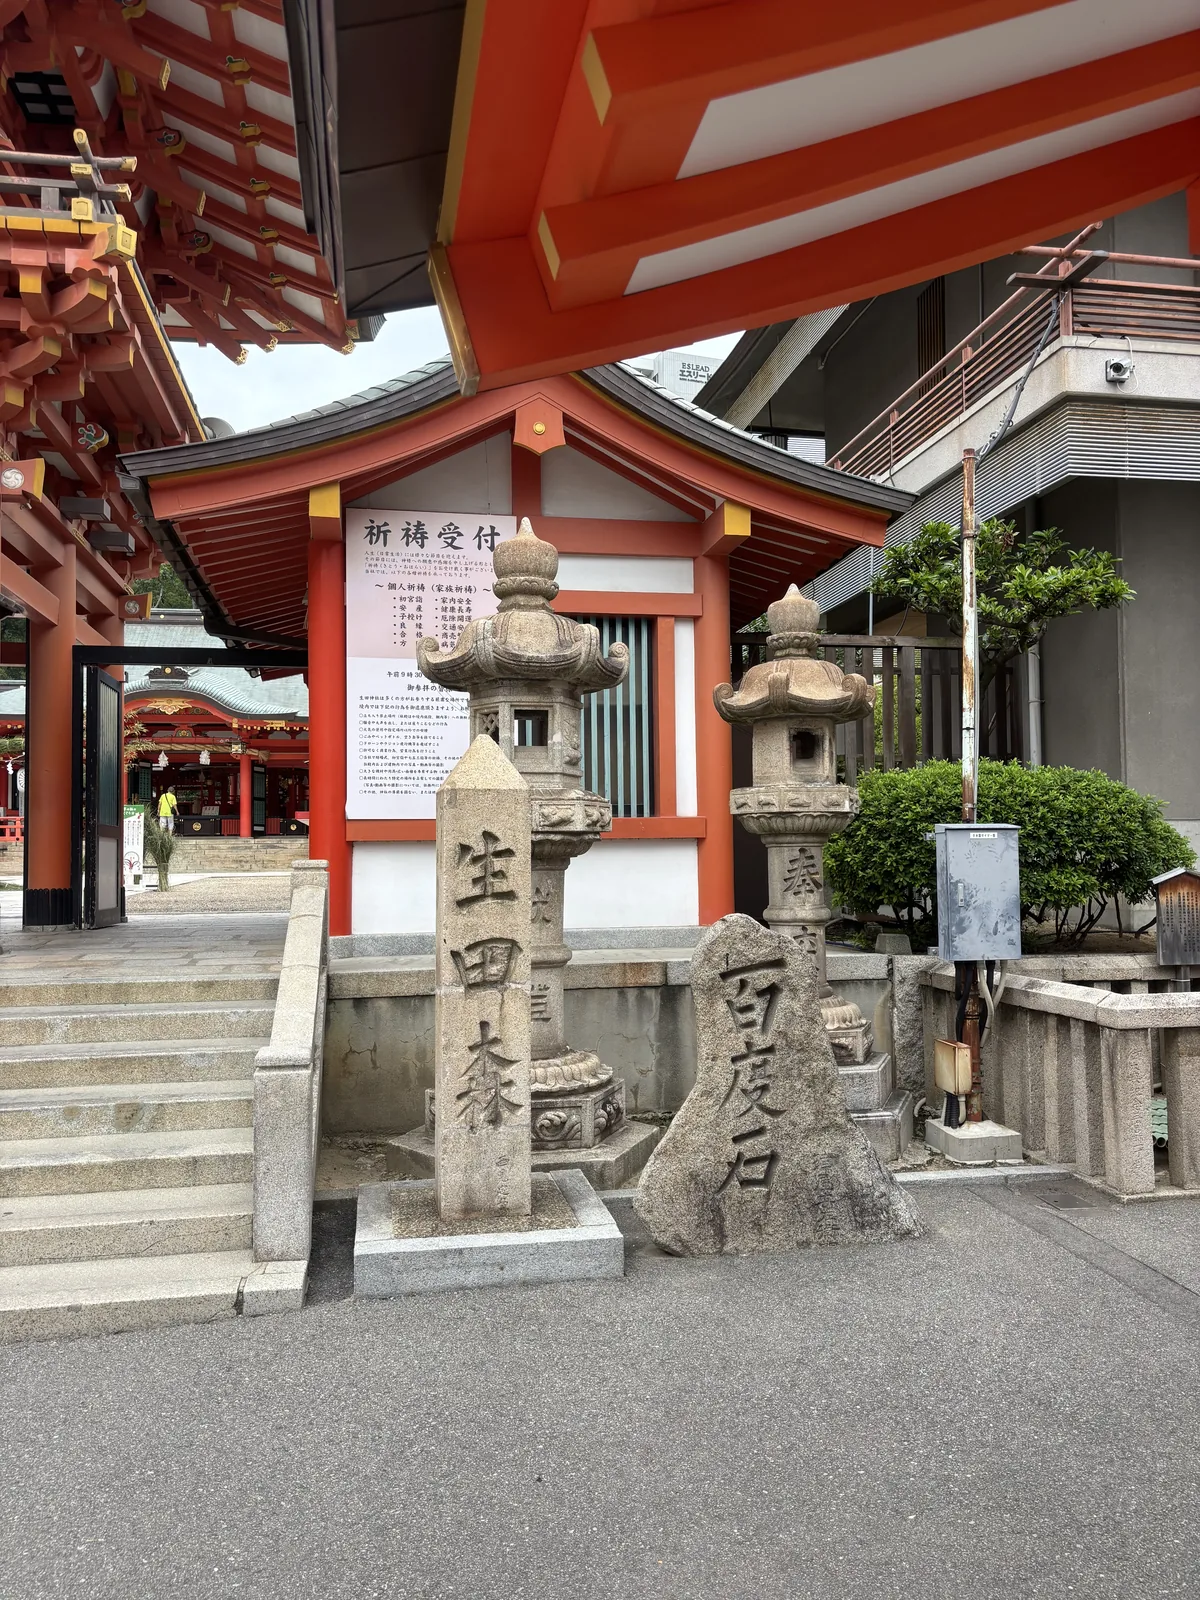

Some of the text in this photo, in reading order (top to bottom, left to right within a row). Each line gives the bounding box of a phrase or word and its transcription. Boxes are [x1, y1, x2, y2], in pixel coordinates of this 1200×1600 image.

[681, 362, 710, 373] ESLEAD
[363, 518, 501, 553] 祈祷受付
[715, 957, 789, 1196] 百度石
